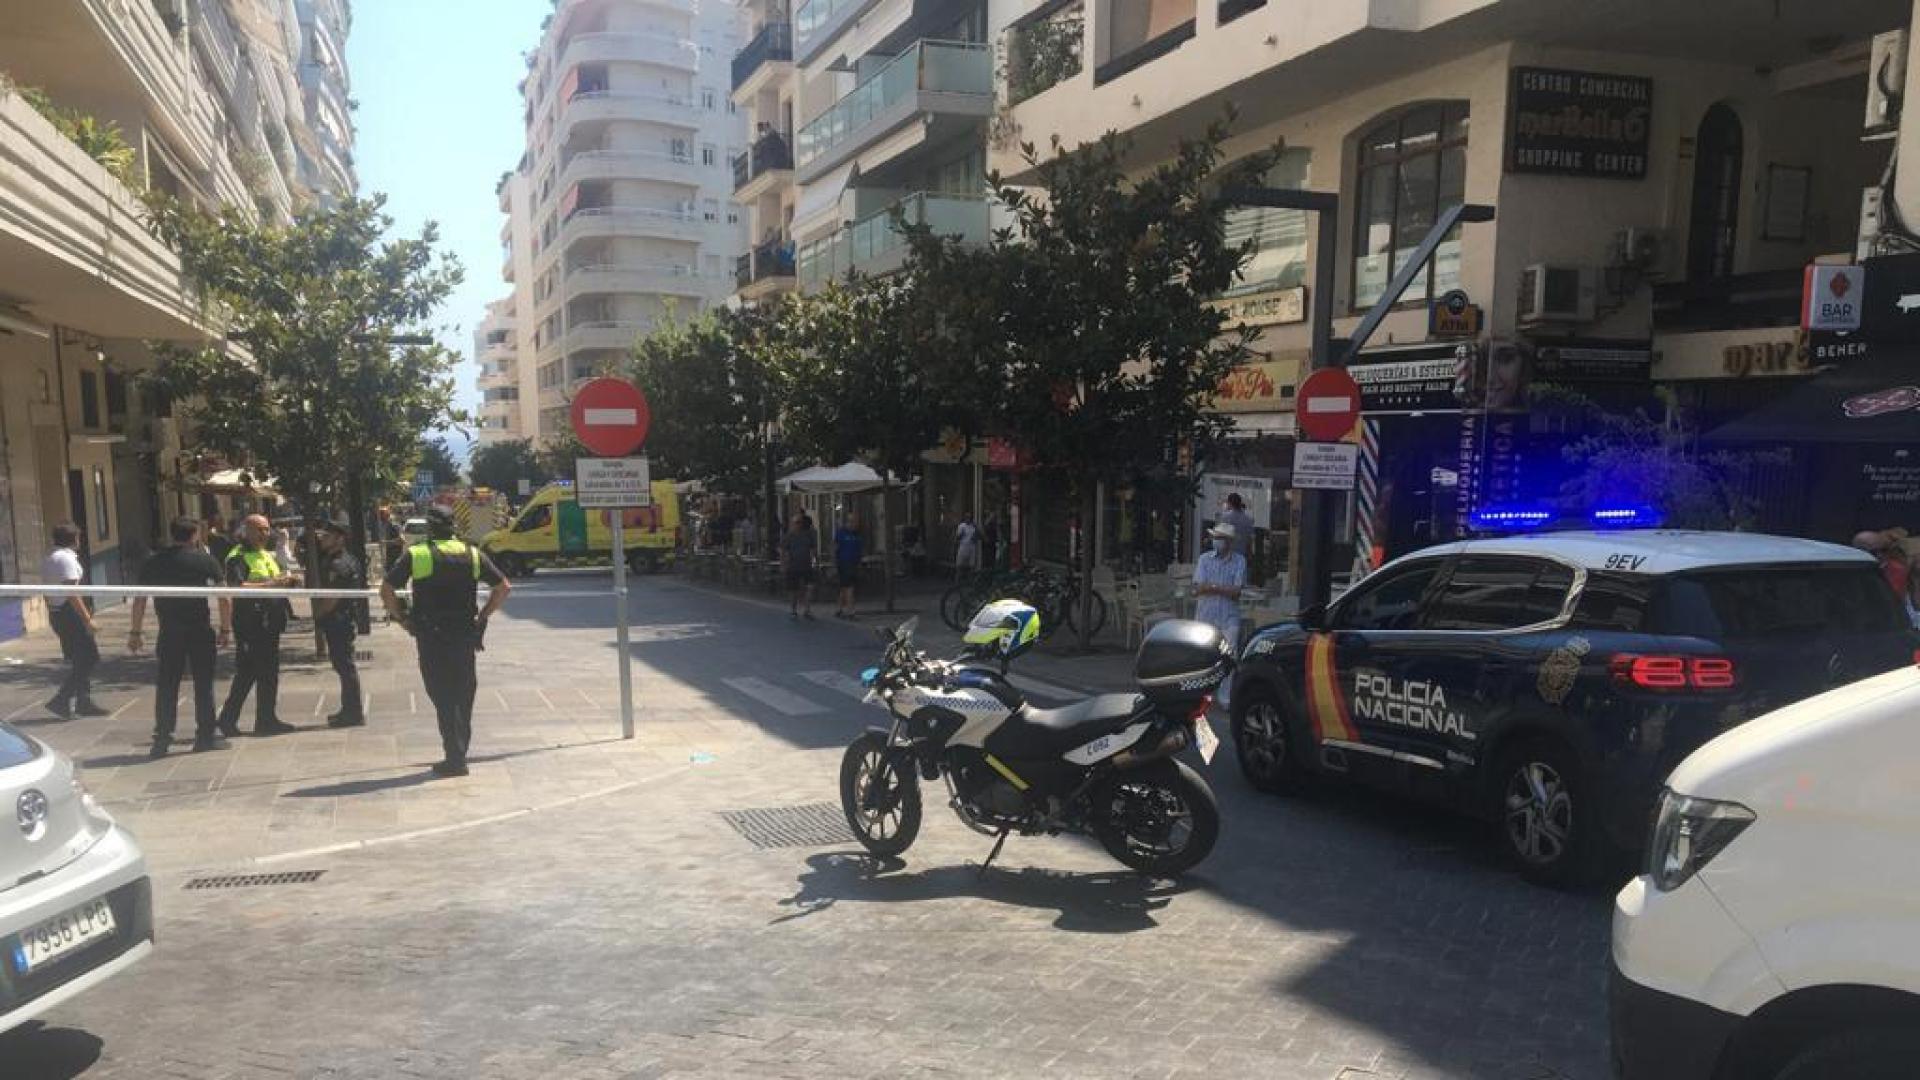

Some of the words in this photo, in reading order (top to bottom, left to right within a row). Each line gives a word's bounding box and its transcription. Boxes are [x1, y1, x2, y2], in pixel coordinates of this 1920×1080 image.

[1822, 303, 1854, 317] BAR
[1440, 319, 1468, 331] ATM
[1605, 553, 1648, 571] 9EV
[1355, 672, 1447, 709] POLICÍA
[1355, 696, 1477, 741] NACIONAL
[23, 917, 73, 961] 7956
[74, 901, 108, 936] LPG
